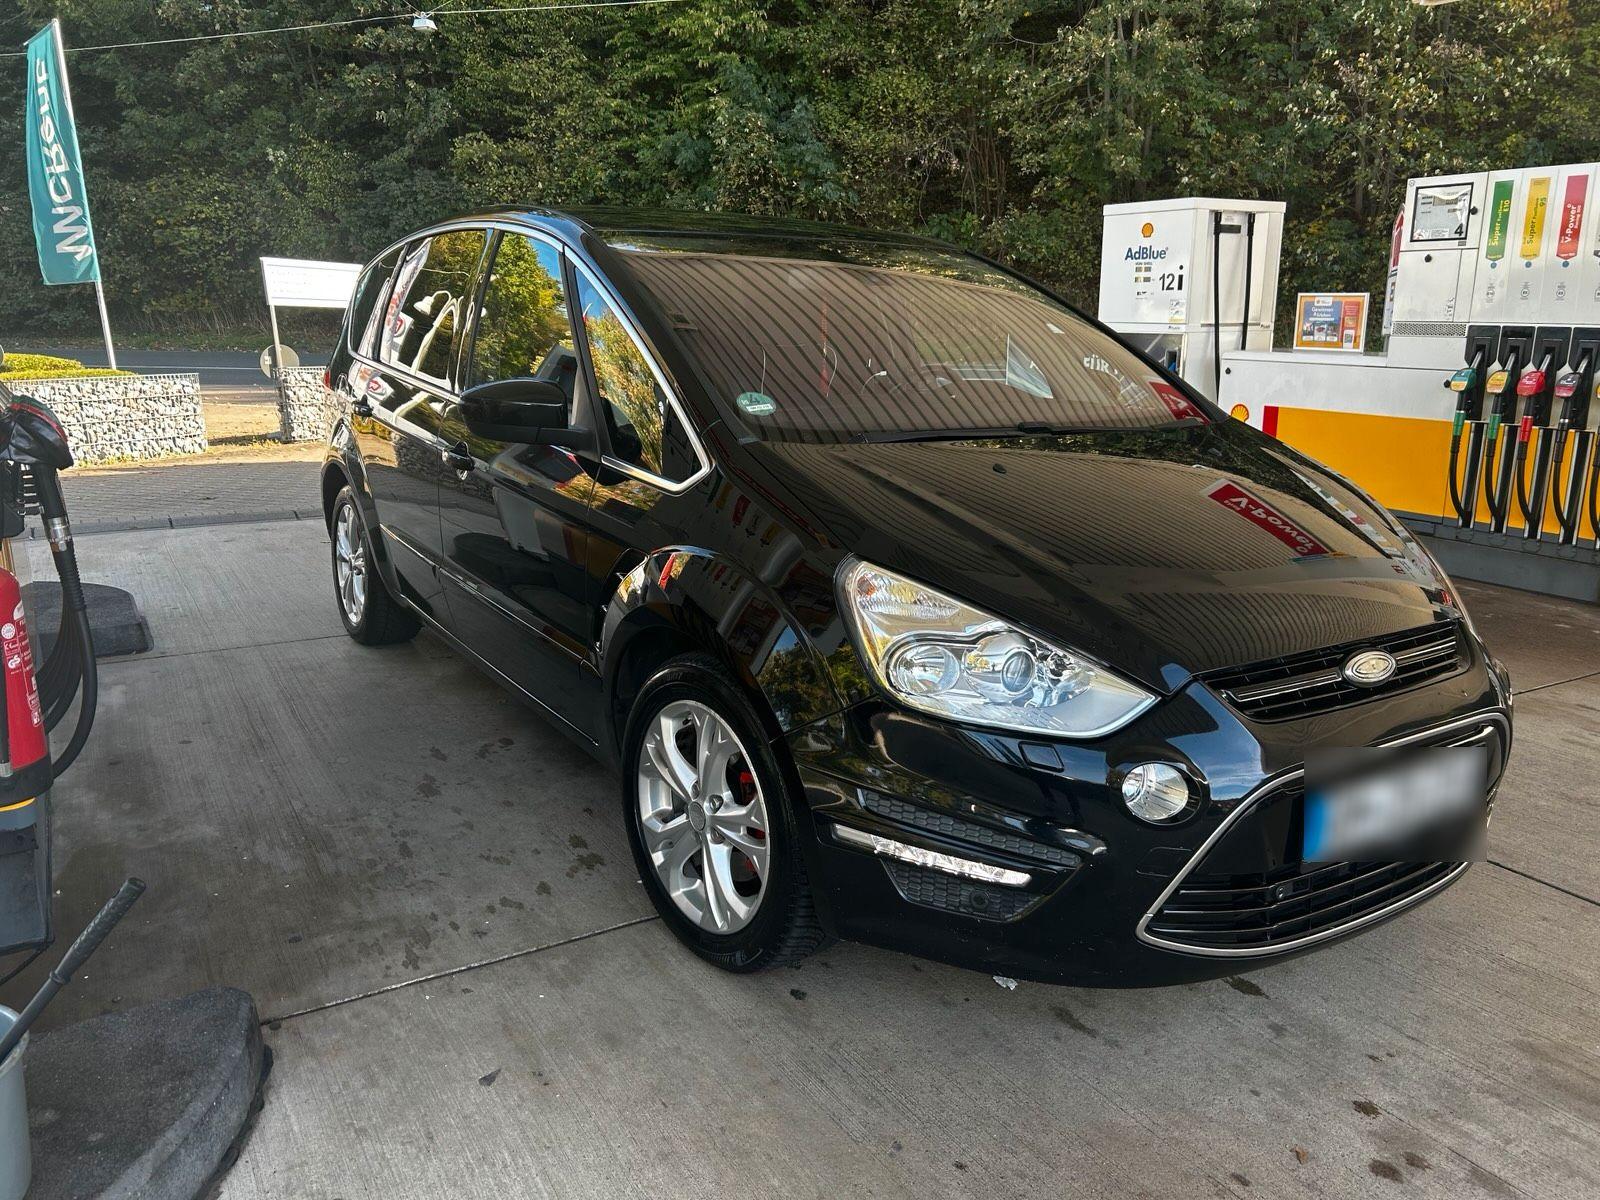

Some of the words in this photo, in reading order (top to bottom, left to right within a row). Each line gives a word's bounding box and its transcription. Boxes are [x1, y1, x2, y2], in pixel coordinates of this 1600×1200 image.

[1503, 199, 1511, 212] E10
[1454, 224, 1464, 237] 4
[1491, 222, 1502, 246] Super
[1527, 221, 1537, 244] Super
[1564, 206, 1577, 244] V-Power
[1124, 245, 1167, 260] AdBlue
[1159, 273, 1175, 291] 12
